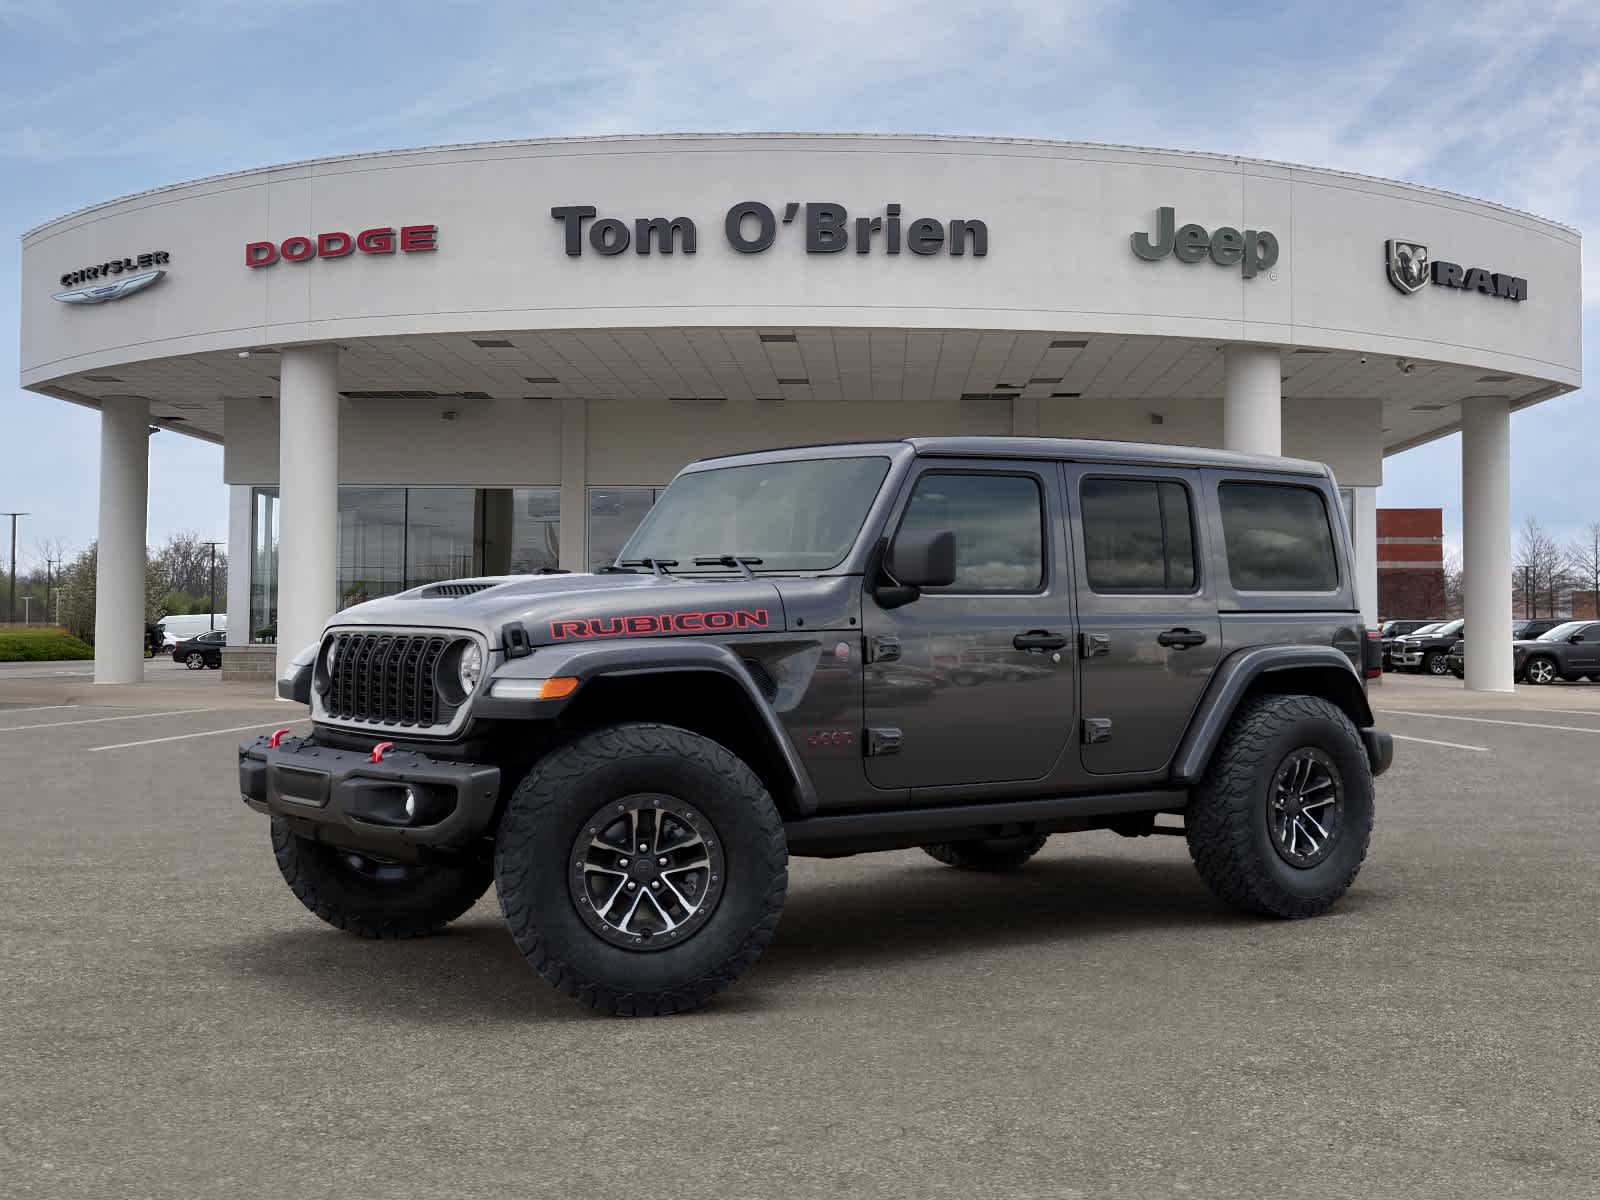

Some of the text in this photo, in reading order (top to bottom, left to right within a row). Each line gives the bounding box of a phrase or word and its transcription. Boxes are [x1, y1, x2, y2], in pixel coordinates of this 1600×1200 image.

[245, 225, 438, 269] DODGE
[551, 201, 988, 257] Tom O'Brien
[1131, 206, 1280, 279] Jeep
[60, 250, 170, 287] CHRYSLER
[1431, 260, 1527, 302] RAM
[550, 609, 769, 640] RUBICON
